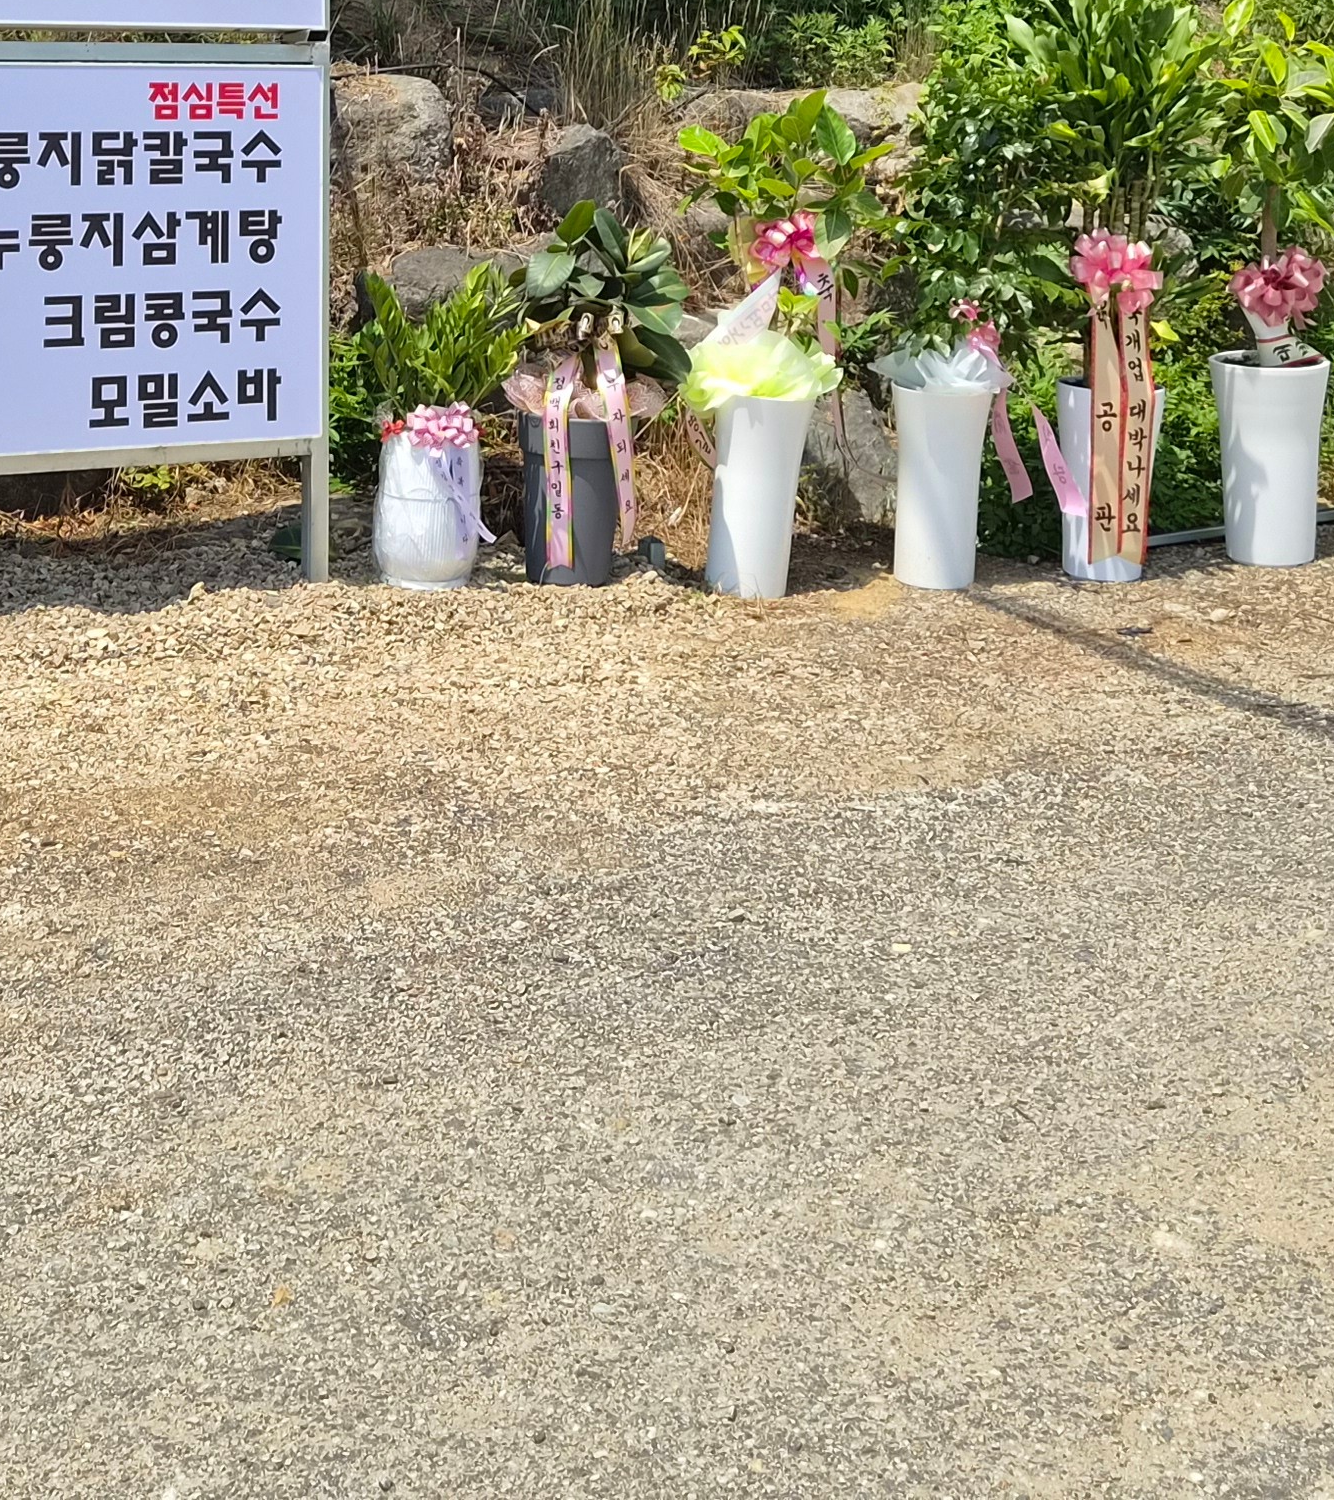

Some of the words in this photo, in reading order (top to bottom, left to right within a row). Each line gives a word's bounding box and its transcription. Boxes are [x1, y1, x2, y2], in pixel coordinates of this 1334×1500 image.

[149, 82, 279, 120] 점심특선
[43, 287, 281, 349] 크림콩국수
[89, 367, 282, 429] 모밀소바
[1121, 398, 1148, 534] 대박나세요
